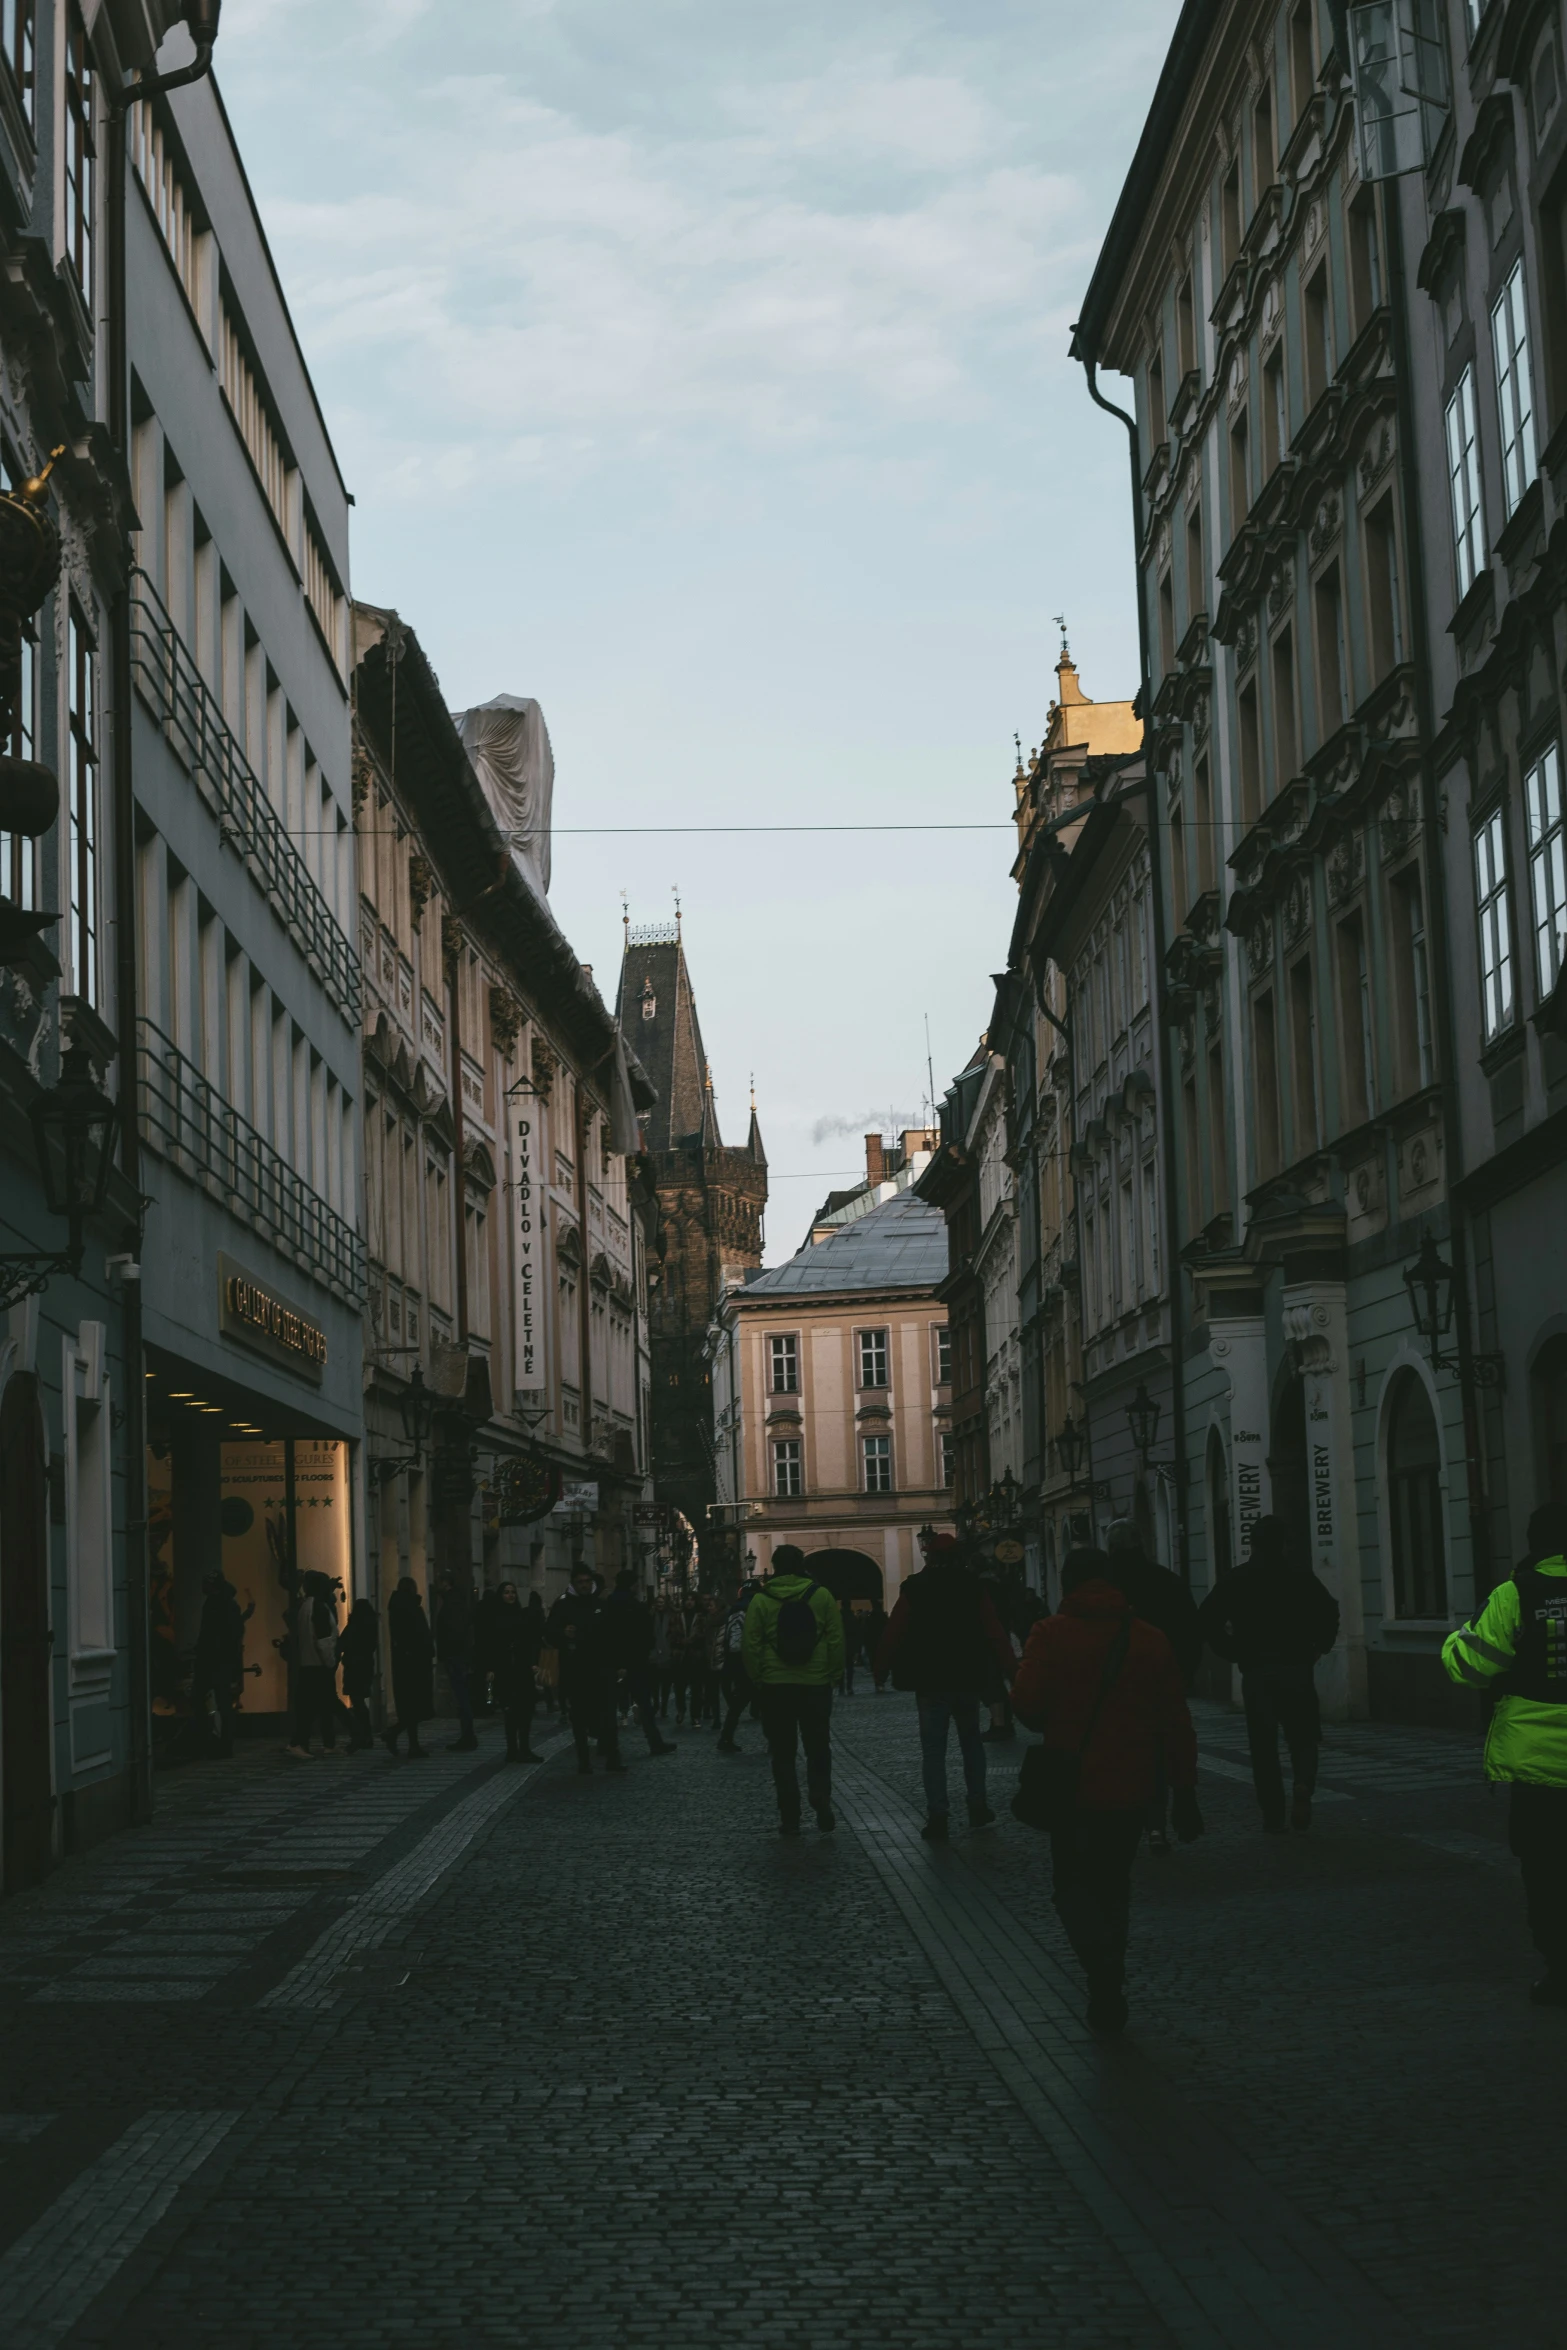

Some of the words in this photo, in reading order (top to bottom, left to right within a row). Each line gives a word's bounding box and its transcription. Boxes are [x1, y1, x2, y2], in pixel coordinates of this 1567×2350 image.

[518, 1120, 531, 1233] DIVADLO
[236, 1277, 271, 1331] GALLERY
[272, 1302, 281, 1336] OF
[282, 1309, 302, 1349] STEEL
[302, 1322, 328, 1364] FIGURES
[521, 1263, 533, 1374] CELETNÉ
[225, 1456, 241, 1466] OF
[245, 1455, 281, 1465] STEEL
[294, 1454, 334, 1464] GURES
[232, 1475, 285, 1483] SCULPTURES
[301, 1474, 334, 1482] FLOORS
[1314, 1444, 1333, 1536] BREWERY
